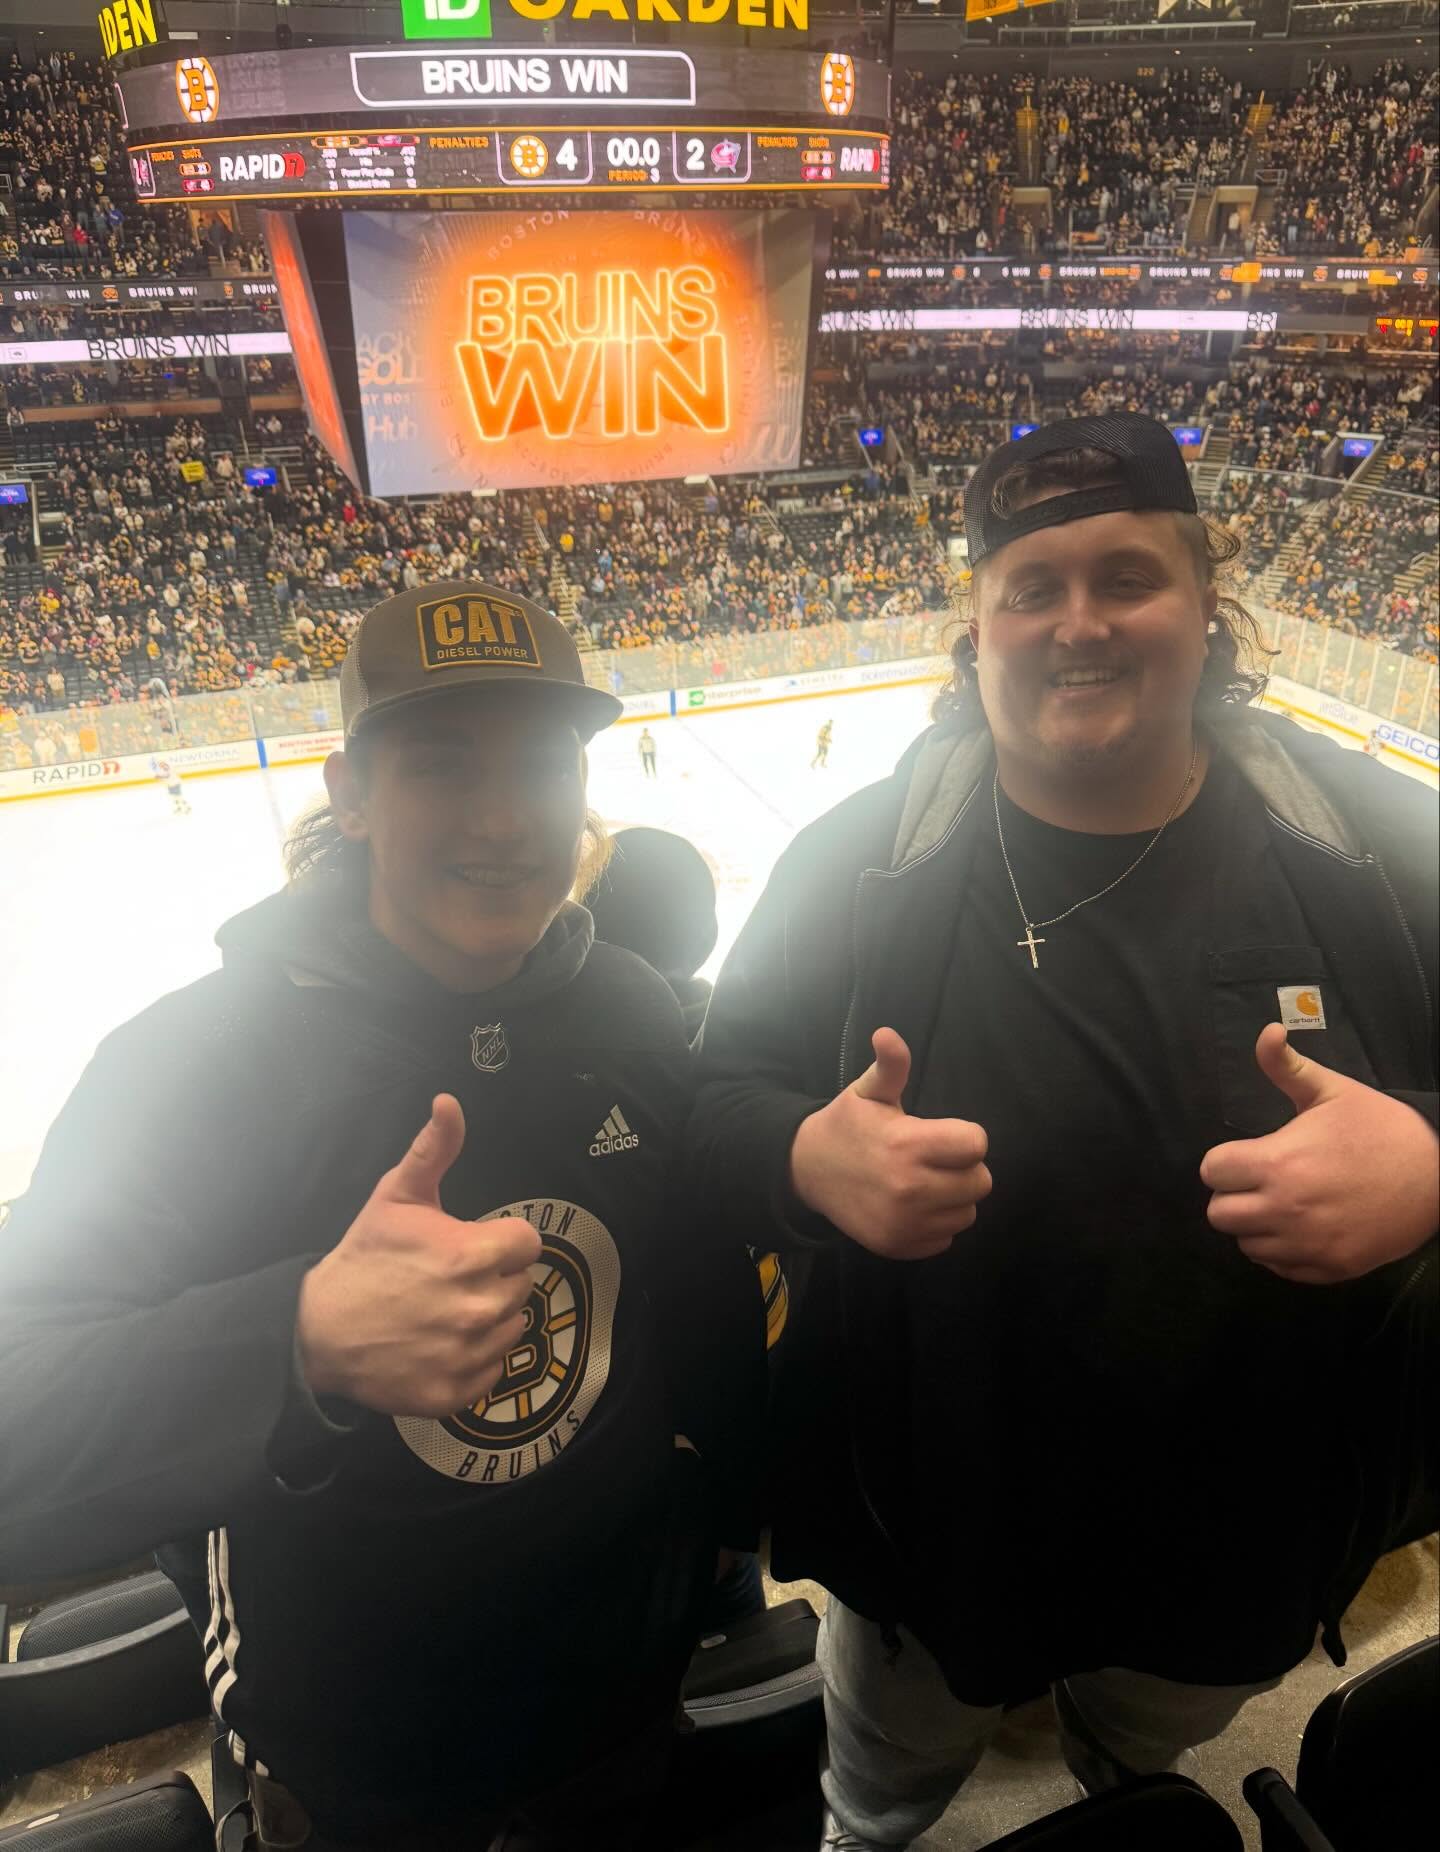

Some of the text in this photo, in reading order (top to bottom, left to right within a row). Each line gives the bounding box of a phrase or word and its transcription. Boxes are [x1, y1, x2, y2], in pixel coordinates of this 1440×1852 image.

[421, 59, 628, 94] BRUINS WIN
[556, 138, 578, 171] 4
[607, 138, 660, 167] 00.0
[686, 138, 705, 170] 2
[467, 265, 718, 350] BRUINS
[819, 311, 871, 332] RUINS
[1021, 308, 1133, 329] BRUINS WIN
[87, 334, 231, 360] BRUINS WIN
[455, 332, 729, 441] WIN
[433, 601, 519, 646] CAT
[437, 647, 528, 659] DIESEL POWER
[1376, 723, 1438, 761] GEICO
[481, 1035, 504, 1064] NHL
[589, 1132, 639, 1156] adidas
[501, 1203, 576, 1236] TON
[456, 1409, 580, 1482] BRUINS
